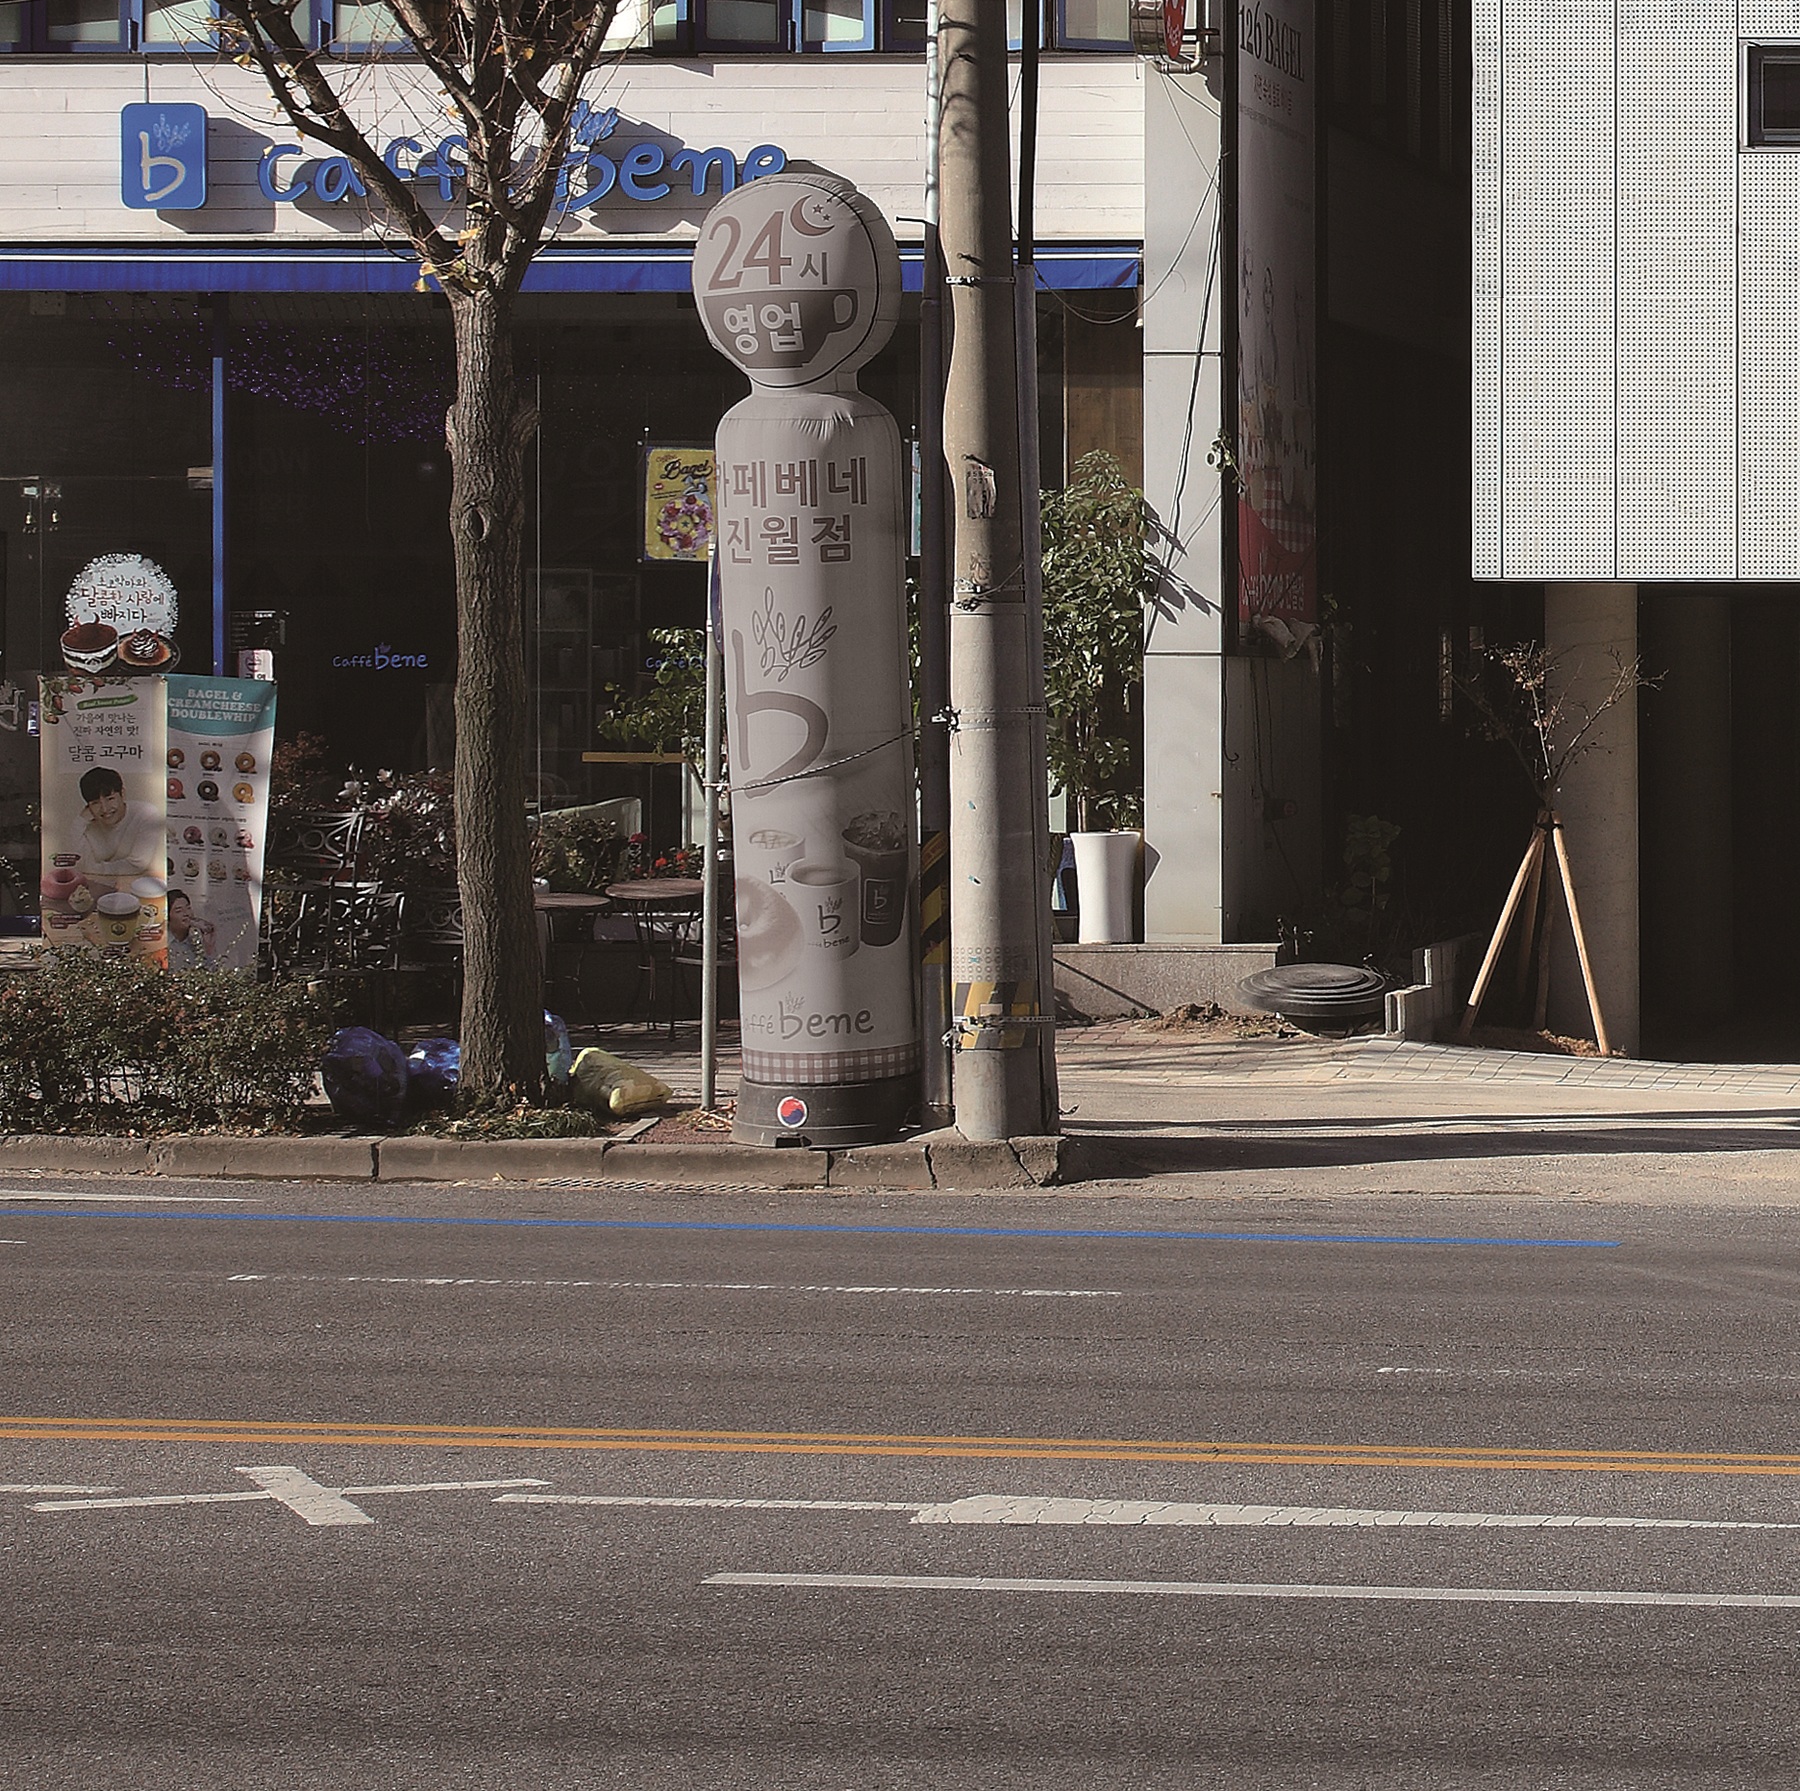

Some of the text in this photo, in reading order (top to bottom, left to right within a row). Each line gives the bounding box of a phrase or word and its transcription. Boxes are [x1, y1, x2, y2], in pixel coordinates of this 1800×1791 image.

[1240, 1, 1304, 82] 126 BAGEL
[724, 302, 805, 355] 영업
[660, 459, 713, 479] Bagel
[727, 515, 852, 565] 진월점
[81, 587, 165, 608] 달콤한 사랑에
[100, 605, 147, 623] 빠지다
[374, 646, 428, 670] bene
[188, 689, 243, 699] BAGEL &
[168, 698, 261, 712] CREAMCHEESE
[171, 708, 256, 722] DOUBLEWHIP
[68, 745, 143, 762] 달콤 고구마
[779, 1001, 874, 1040] bene
